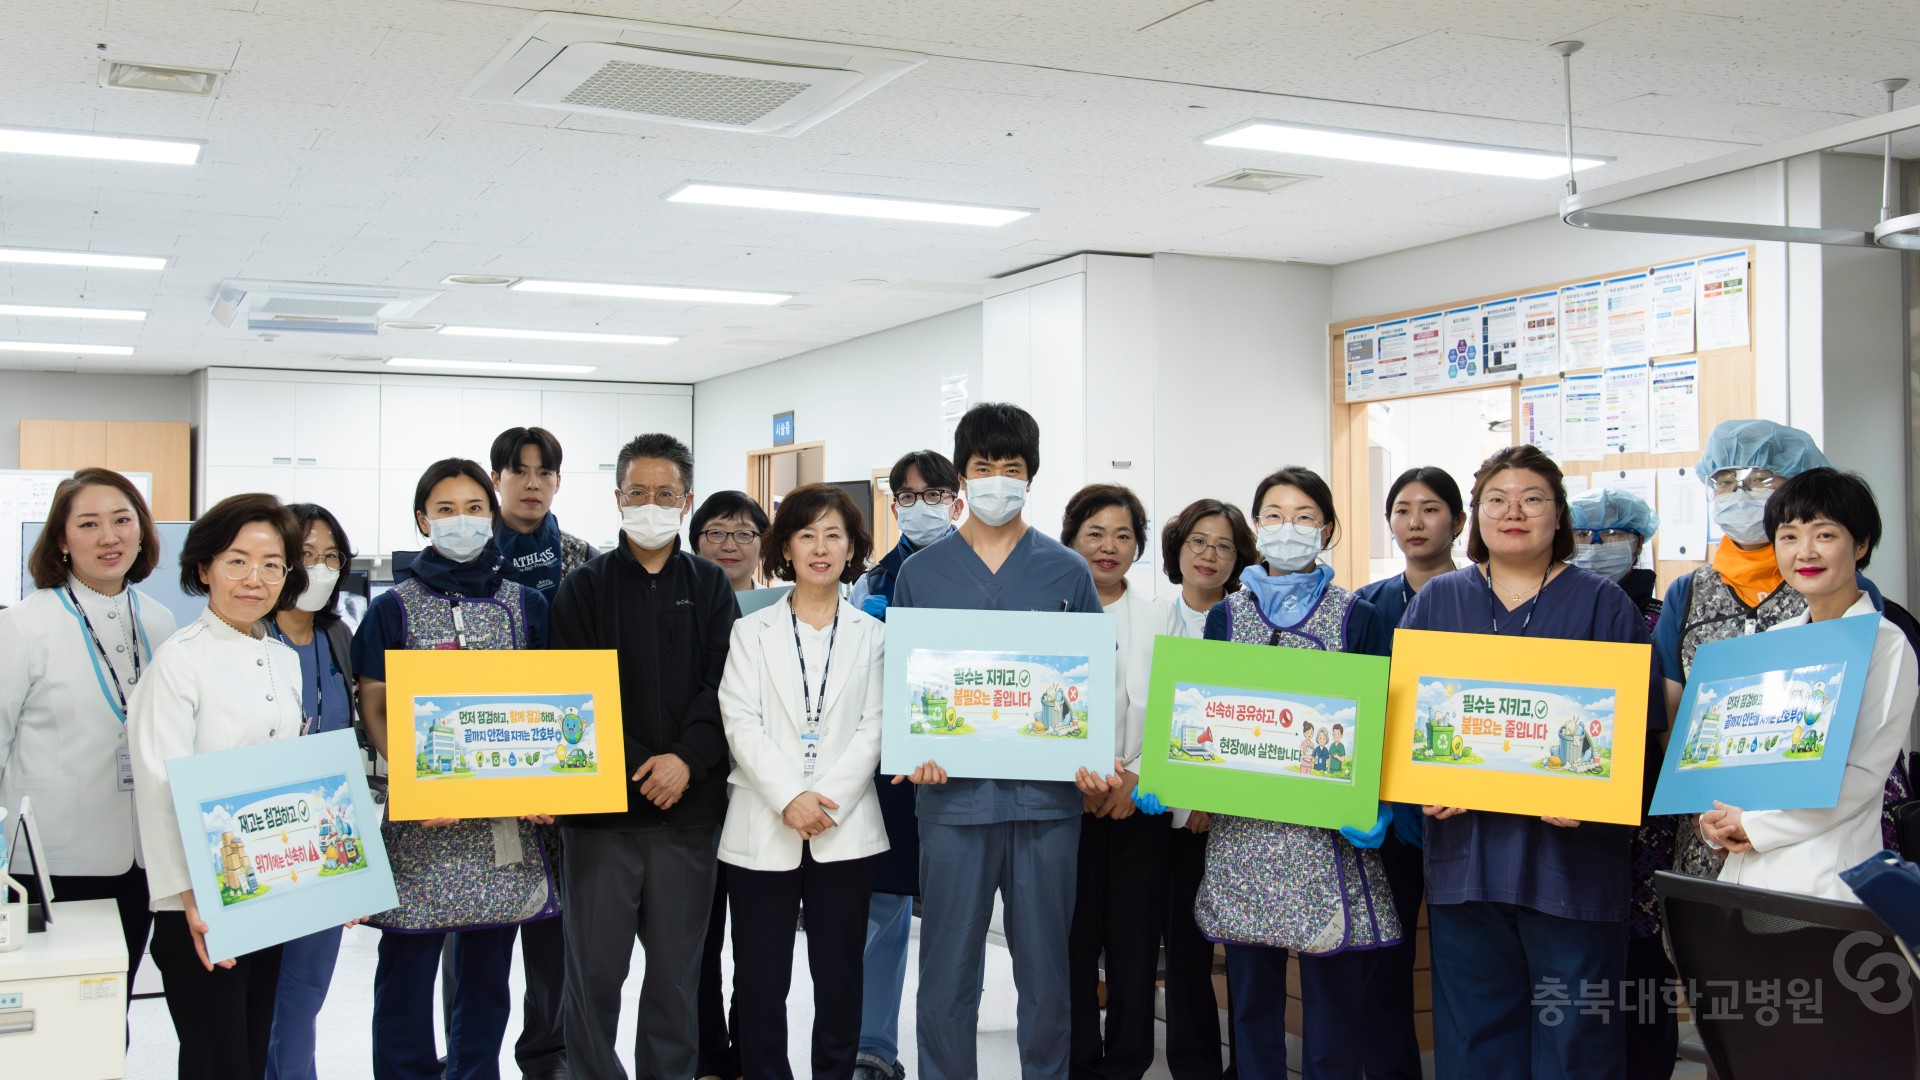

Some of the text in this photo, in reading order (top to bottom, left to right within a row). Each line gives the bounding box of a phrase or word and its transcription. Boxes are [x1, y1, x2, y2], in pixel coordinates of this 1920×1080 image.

[775, 421, 791, 437] 시술중
[953, 667, 1018, 688] 필수는 지키고,
[953, 687, 1032, 707] 불필요는 줄입니다
[1462, 694, 1534, 719] 필수는 지키고,
[1727, 694, 1740, 710] 먼저
[459, 711, 476, 725] 먼저
[477, 711, 509, 725] 점검하고,
[509, 710, 526, 724] 함께
[1205, 701, 1278, 726] 신속히 공유하고,
[1724, 713, 1742, 729] 끝까지
[1742, 712, 1760, 727] 안전을
[464, 727, 555, 743] 끝까지 안전을 지키는 간호부
[1461, 716, 1548, 740] 불필요는 줄입니다
[1219, 736, 1302, 763] 현장에서 실천합니다
[238, 805, 301, 834] 재고는 점검하고,
[255, 845, 308, 873] 위기에는 신속히
